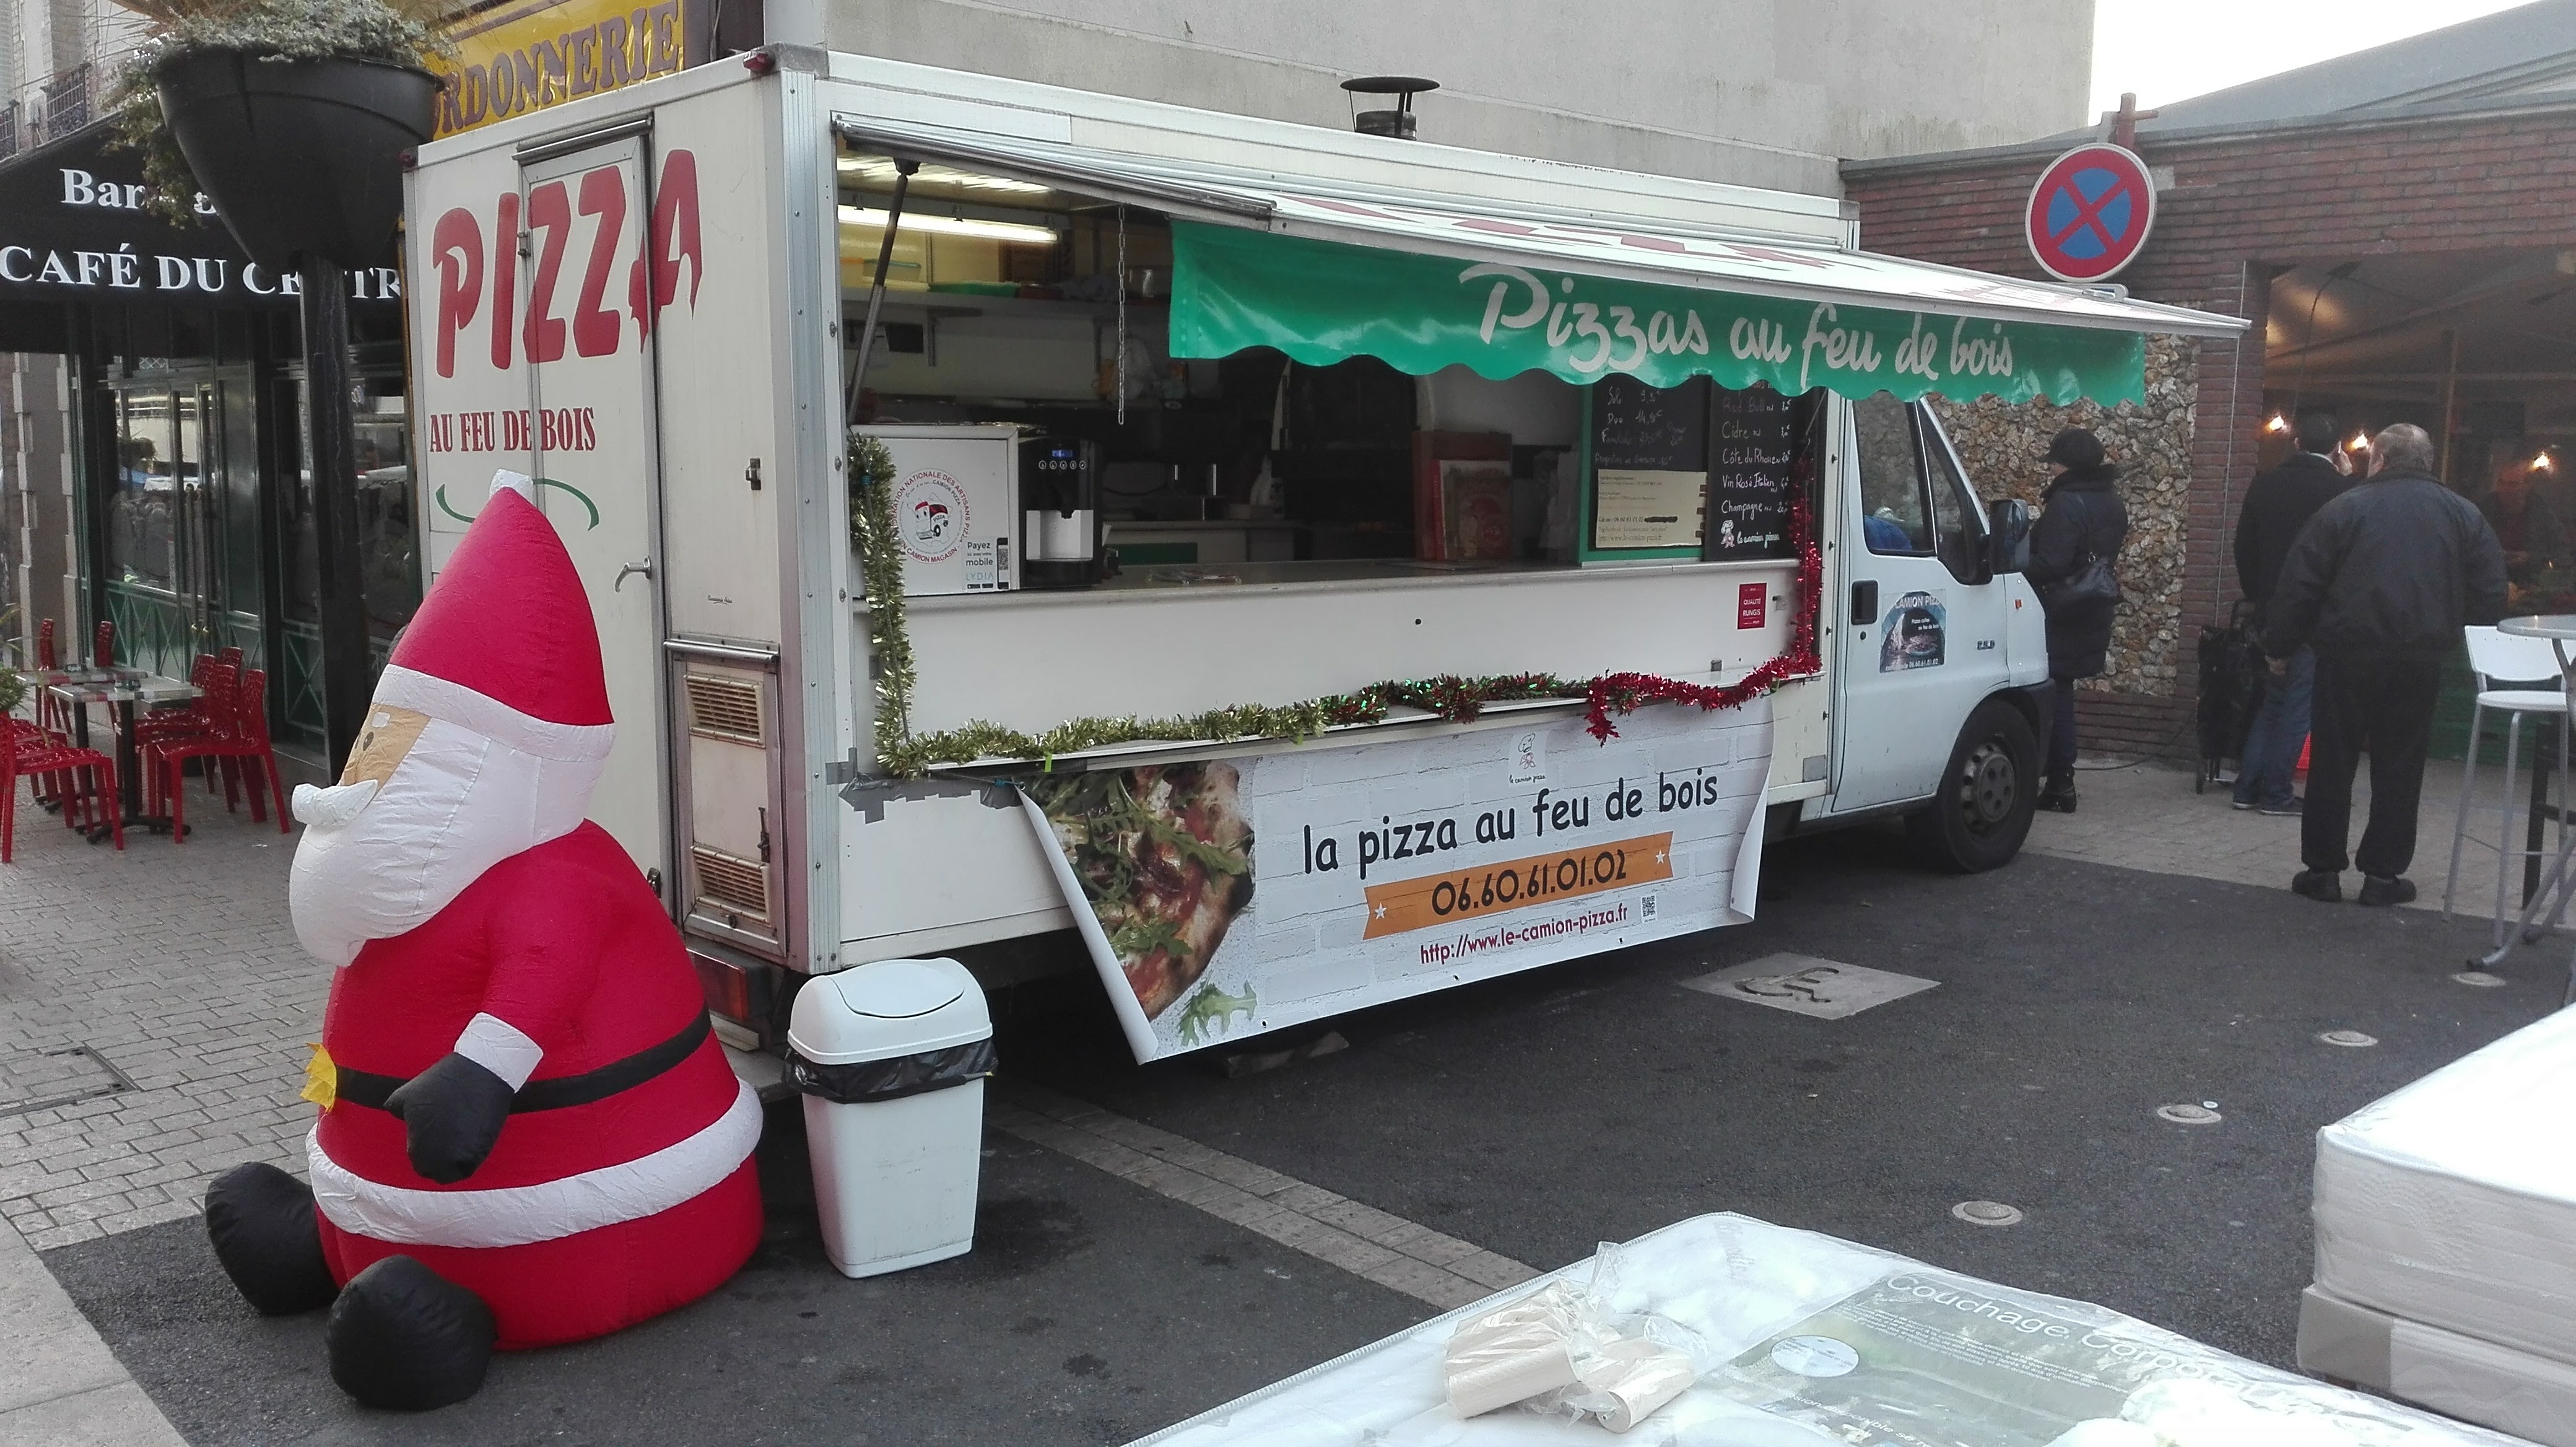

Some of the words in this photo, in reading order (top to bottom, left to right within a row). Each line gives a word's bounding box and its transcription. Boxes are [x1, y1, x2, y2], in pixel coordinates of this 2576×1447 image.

[432, 0, 677, 133] RDONNERIE
[60, 168, 145, 209] Bar
[0, 242, 141, 289] CAFÉ
[154, 255, 227, 293] DU
[432, 149, 703, 378] PIZZA
[1458, 263, 1709, 372] Pizzas
[1730, 317, 1791, 363] au
[1799, 302, 1882, 390] feu
[1895, 312, 1939, 380] de
[1950, 316, 2012, 377] bois
[430, 413, 453, 453] AU
[459, 410, 495, 452] FEU
[503, 408, 533, 452] DE
[539, 406, 596, 452] BOIS
[1722, 420, 1749, 439] Cidre
[904, 471, 941, 488] NATIONALE
[943, 474, 955, 486] DES
[955, 485, 970, 521] ARTISANS
[933, 480, 952, 492] CAMION
[951, 491, 961, 505] PIZZA
[1723, 474, 1734, 488] Vin
[1721, 500, 1763, 520] Champagne
[907, 548, 929, 562] CAMION
[931, 546, 958, 562] MAGASIN
[966, 558, 993, 566] mobile
[967, 542, 991, 551] Payez
[966, 572, 994, 581] LYDIA
[1743, 609, 1761, 617] RUNGIS
[1303, 824, 1338, 874] la
[1359, 815, 1456, 880] pizza
[1476, 807, 1515, 843] au
[1533, 788, 1589, 837] feu
[1605, 777, 1643, 821] de
[1658, 767, 1718, 813] bois
[1431, 849, 1627, 916] 06.60.61.01.02
[1420, 903, 1628, 964] http://www.le-camion-pizza.fr
